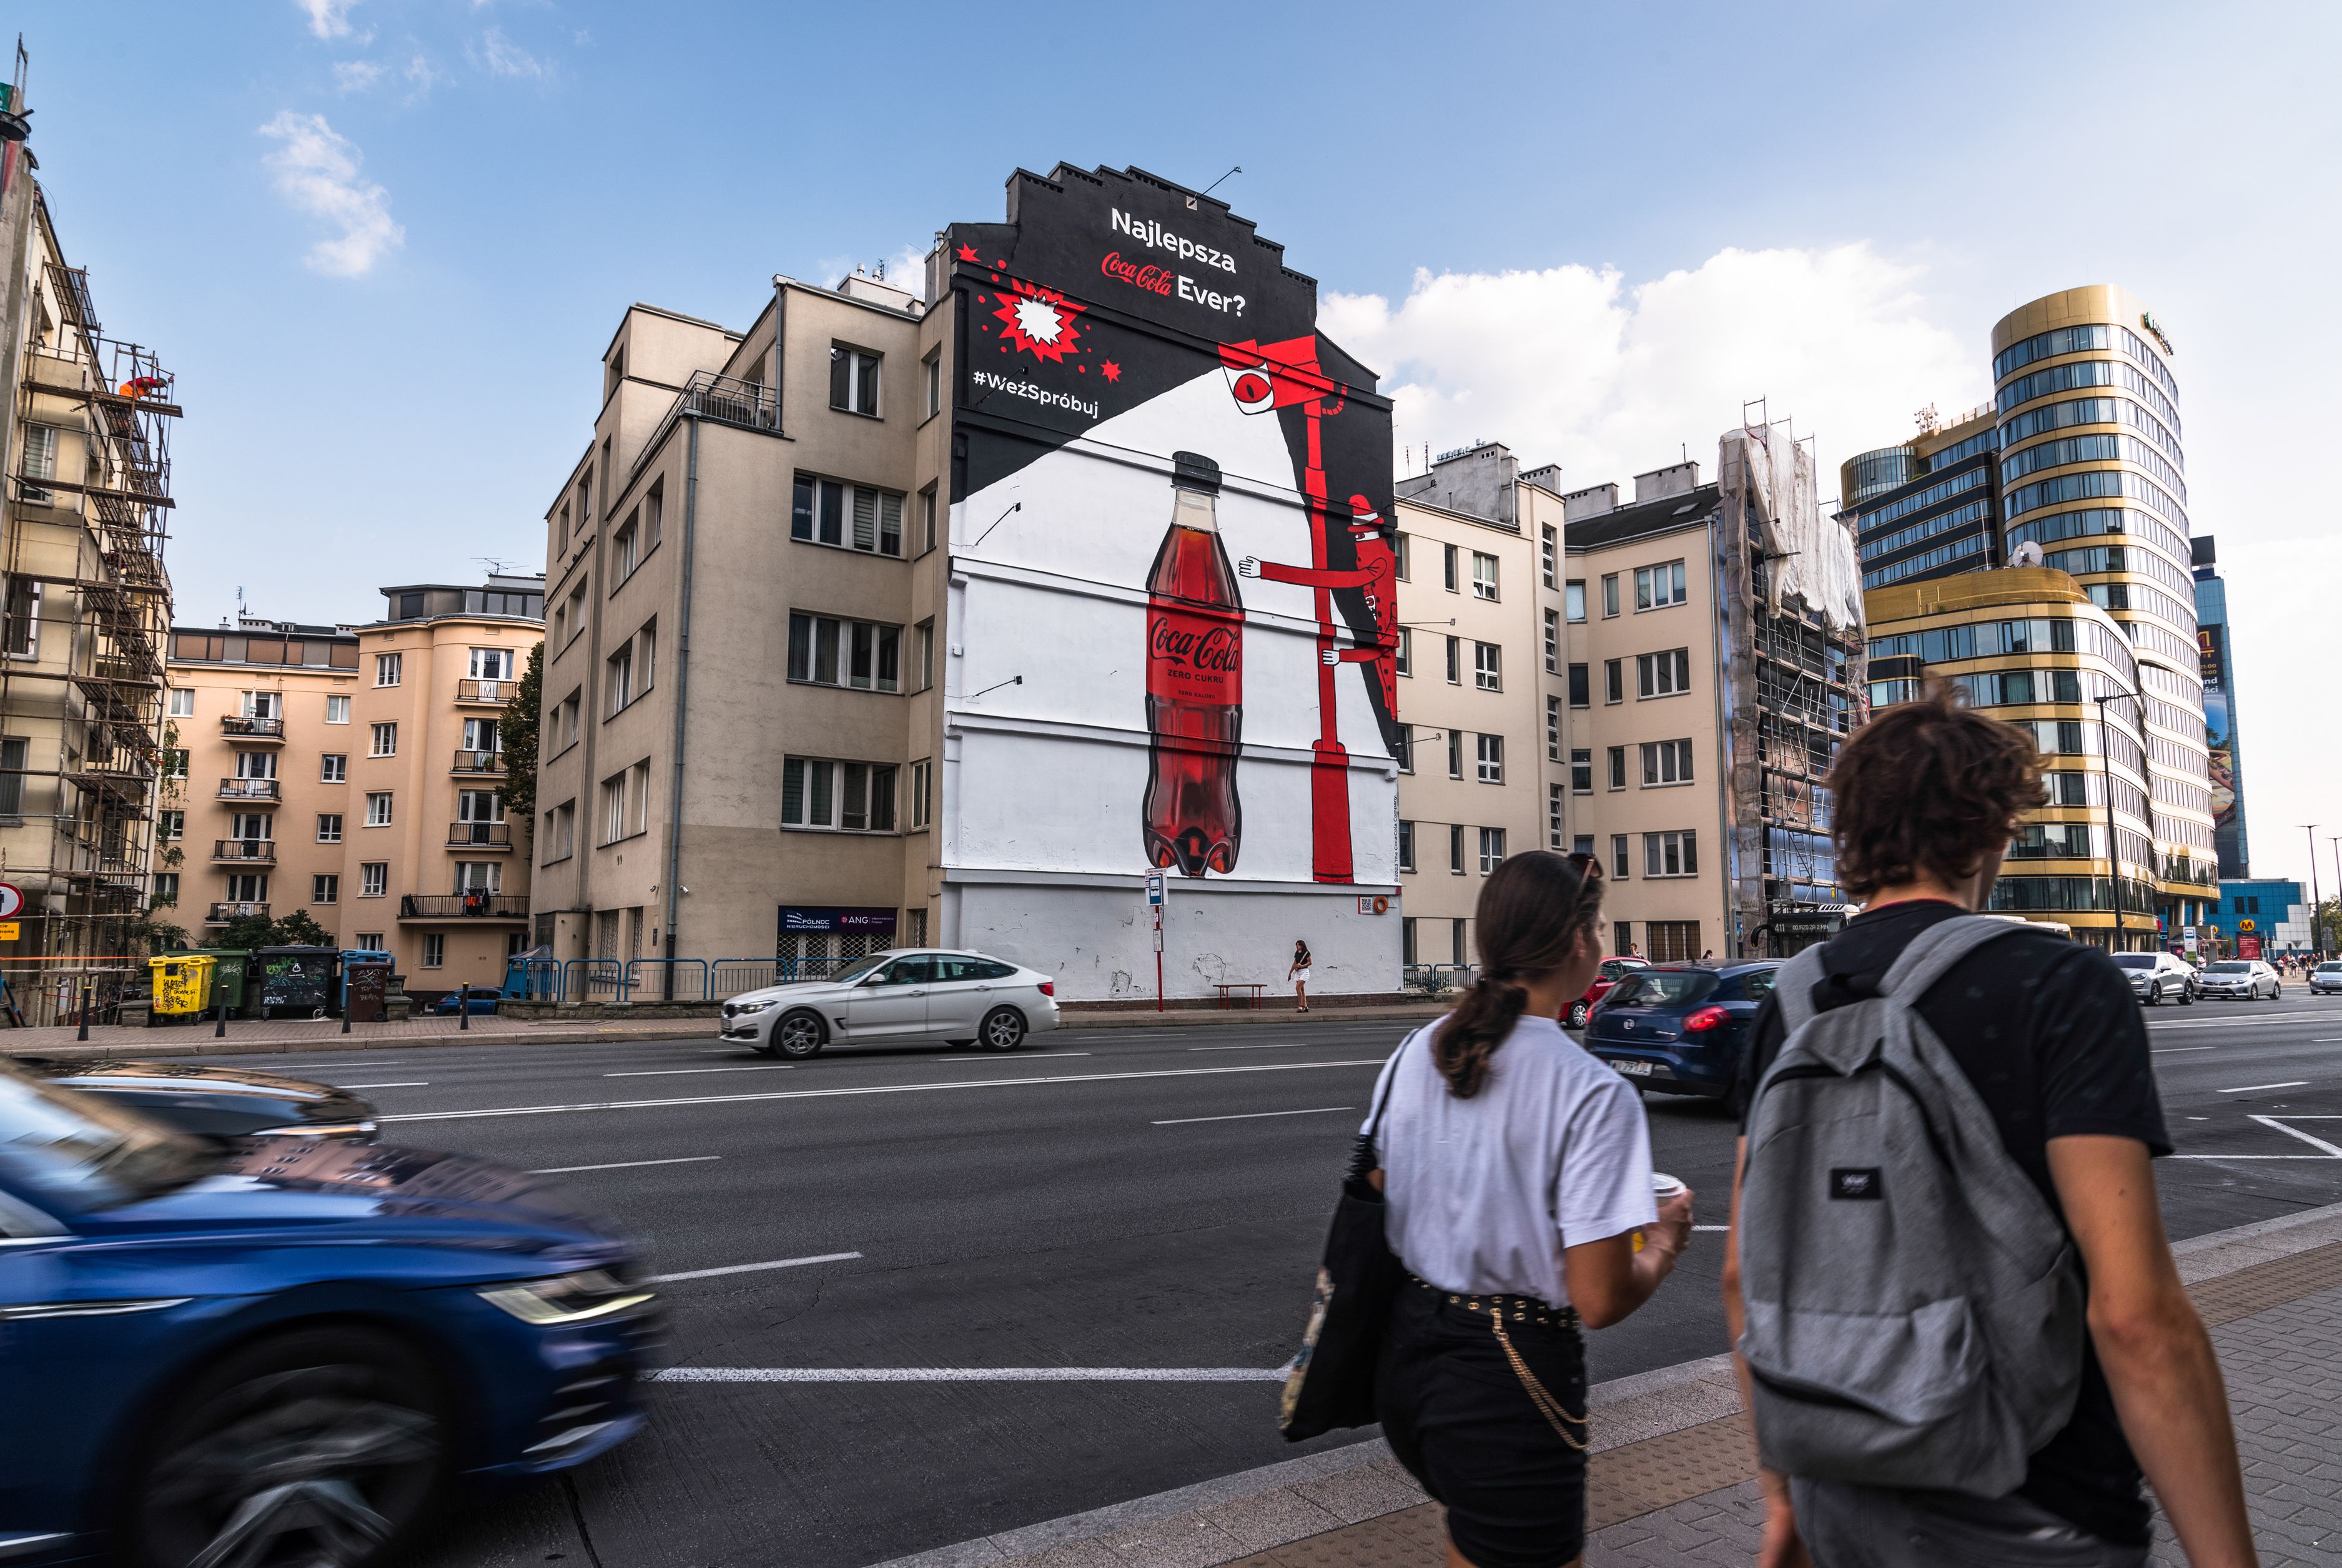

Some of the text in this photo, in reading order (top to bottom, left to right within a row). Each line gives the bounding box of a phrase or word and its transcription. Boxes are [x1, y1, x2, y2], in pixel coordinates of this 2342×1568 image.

[1112, 207, 1237, 274] Najlepsza
[1178, 274, 1246, 317] Ever?
[972, 371, 1099, 419] #WeźSpróbuj
[1150, 616, 1240, 673] Coca-Cola
[1168, 669, 1223, 684] ZERO CUKRU
[1774, 923, 1785, 932] 411
